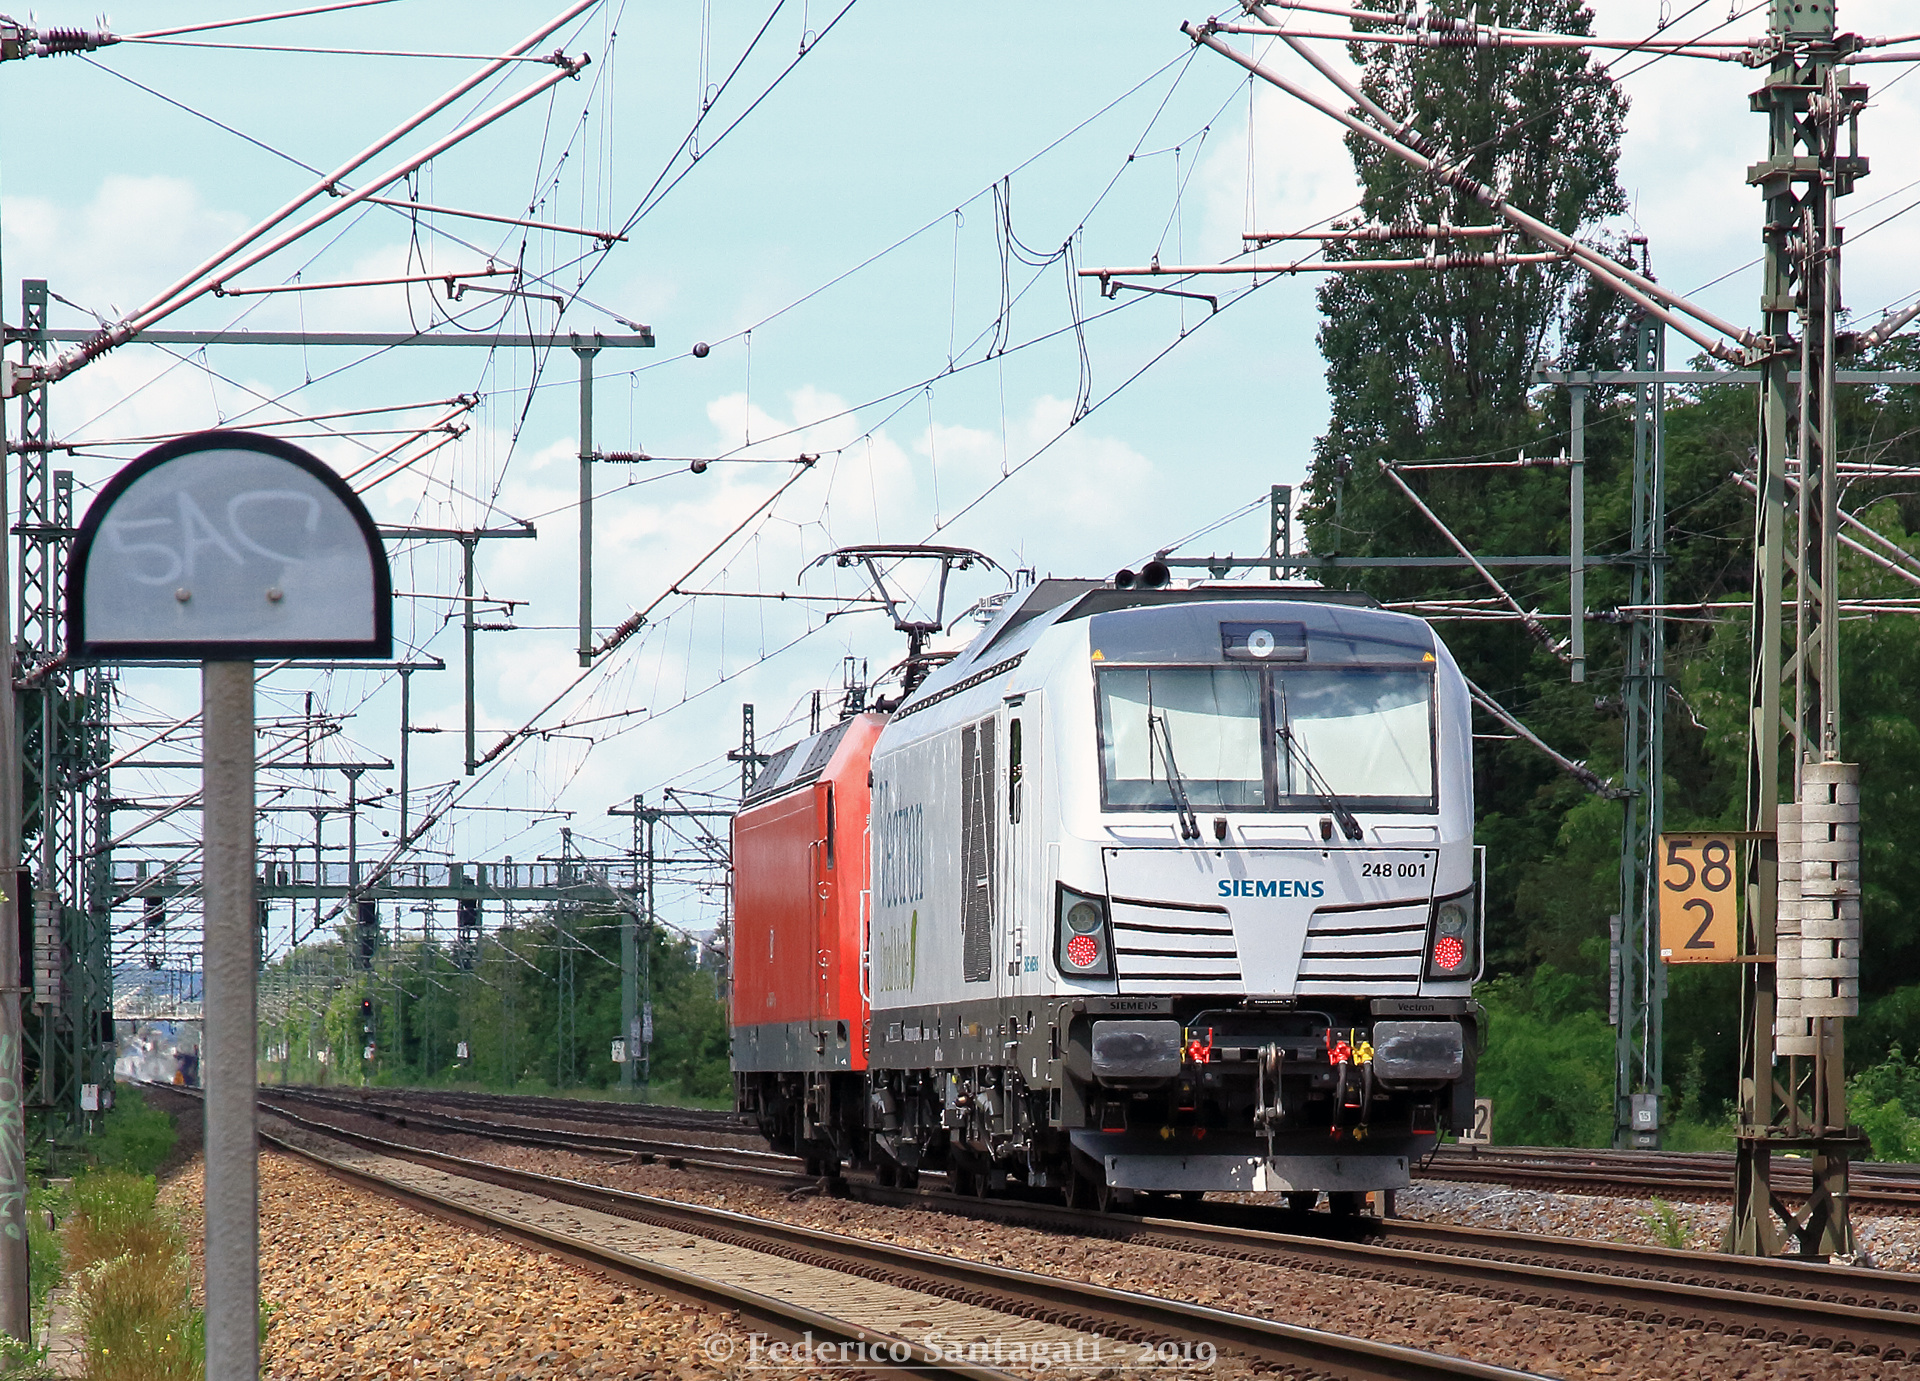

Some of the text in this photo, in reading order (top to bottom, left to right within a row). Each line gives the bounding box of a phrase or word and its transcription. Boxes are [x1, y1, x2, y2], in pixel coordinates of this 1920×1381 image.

[1362, 863, 1425, 877] 248 001
[1664, 840, 1732, 892] 58
[1218, 879, 1325, 898] SIEMENS
[1682, 897, 1715, 949] 2
[1110, 1001, 1158, 1010] SIEMENS
[1398, 1003, 1434, 1011] Vectron
